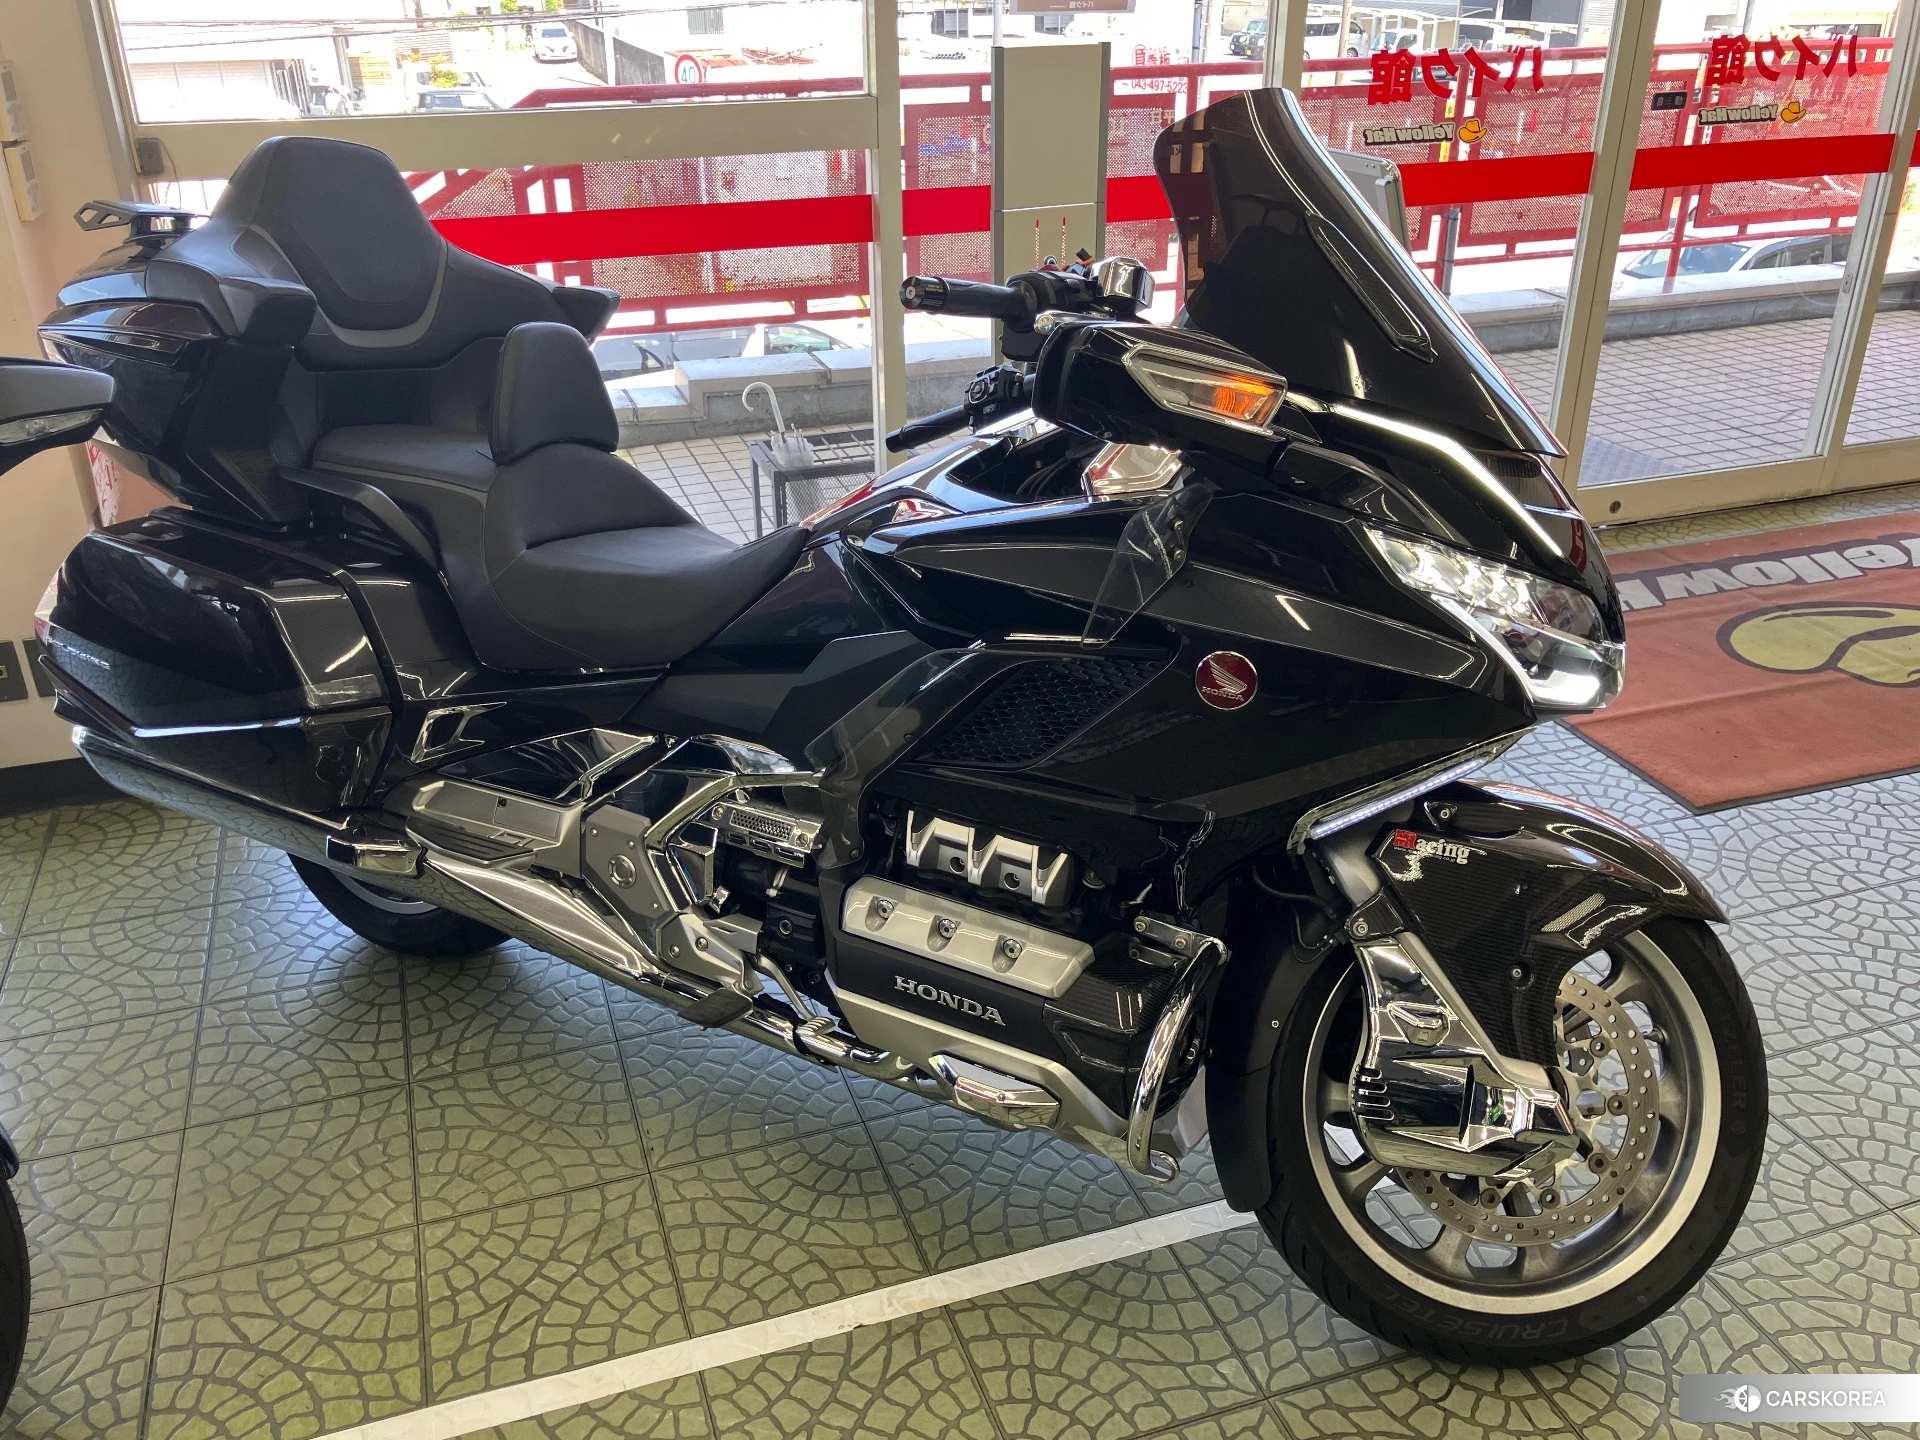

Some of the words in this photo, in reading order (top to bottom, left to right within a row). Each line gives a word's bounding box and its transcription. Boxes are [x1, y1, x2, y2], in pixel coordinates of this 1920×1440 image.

[681, 66, 697, 84] 40
[1201, 686, 1245, 702] HONDA
[894, 975, 1006, 1027] HONDA
